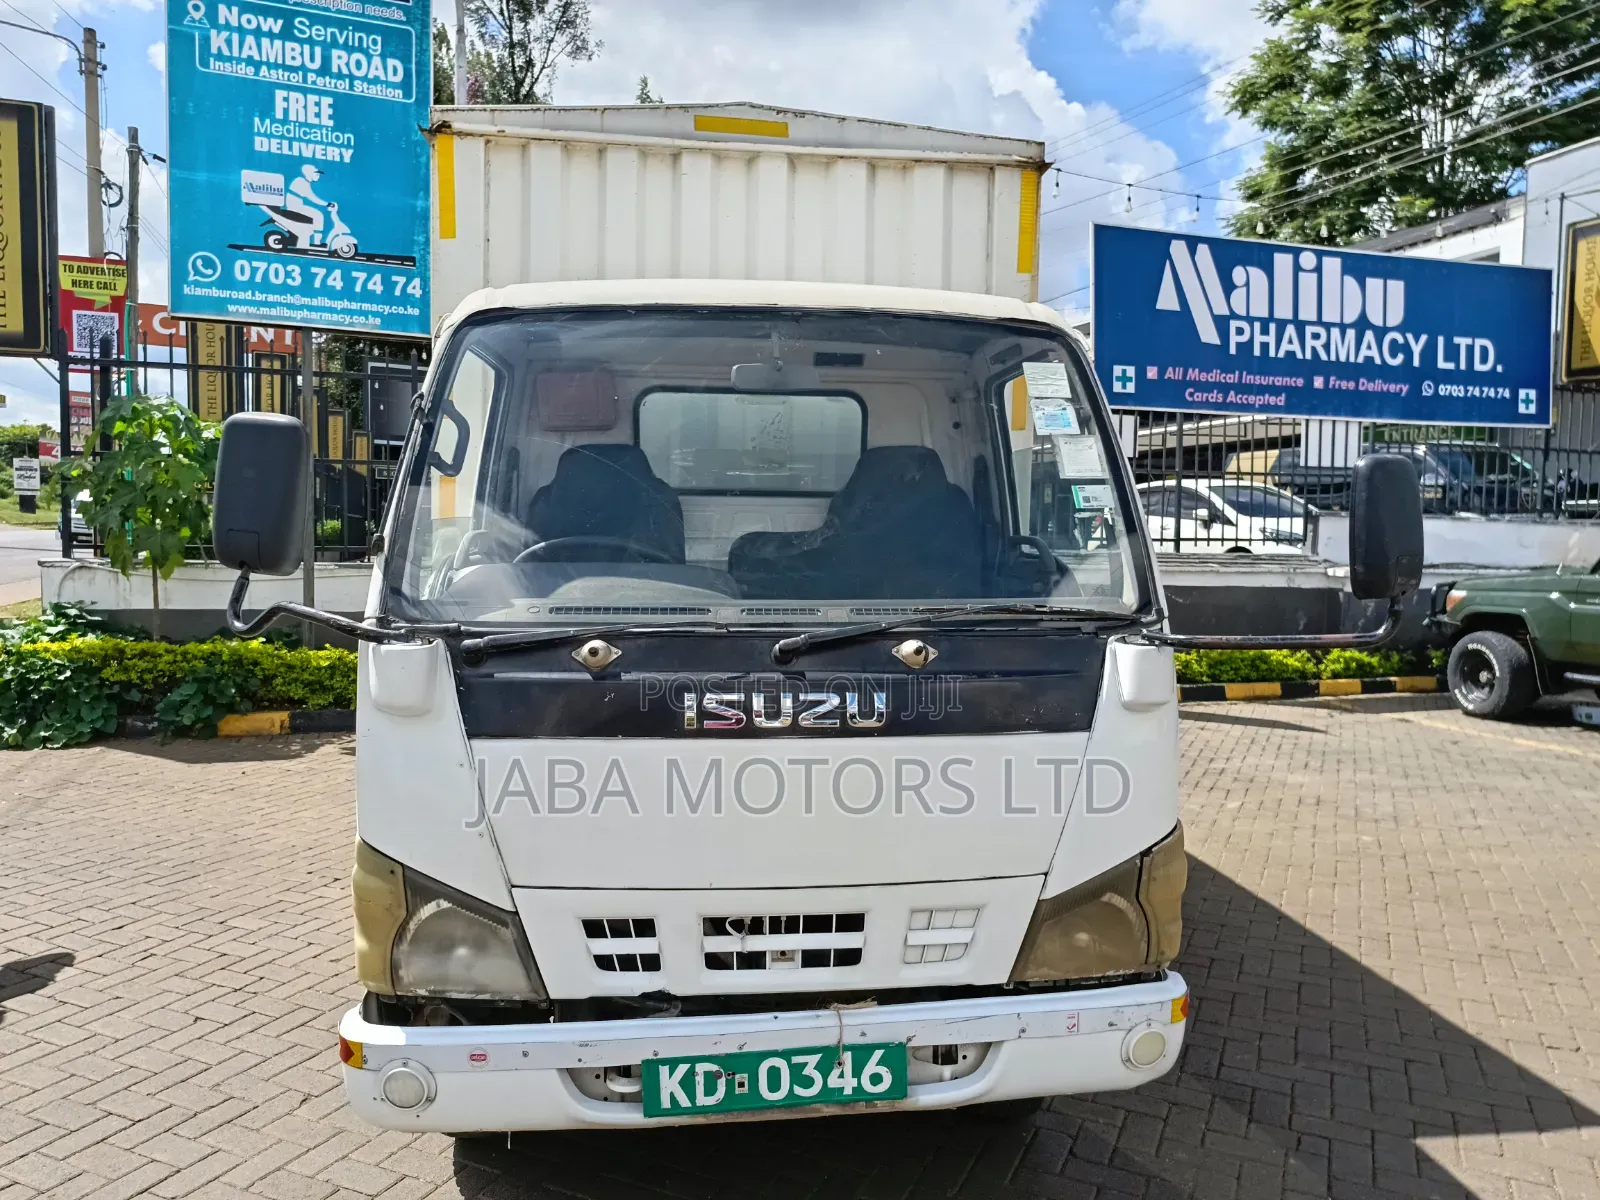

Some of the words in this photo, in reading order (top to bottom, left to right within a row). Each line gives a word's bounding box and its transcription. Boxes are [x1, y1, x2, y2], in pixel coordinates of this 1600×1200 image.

[289, 0, 362, 14] scription
[365, 5, 406, 21] needs.
[218, 4, 283, 34] Now
[293, 18, 382, 55] Serving
[210, 29, 322, 69] KIAMBU
[332, 49, 404, 83] ROAD
[210, 57, 255, 75] Inside
[259, 65, 303, 83] Astrol
[307, 74, 349, 91] Petrol
[353, 80, 403, 99] Station
[275, 89, 334, 126] FREE
[254, 117, 355, 146] Medication
[254, 137, 355, 163] DELIVERY
[243, 181, 284, 193] Malibu
[62, 264, 75, 273] TO
[77, 265, 127, 278] ADVERTISE
[234, 259, 302, 286] 0703
[310, 267, 343, 292] 74
[351, 271, 384, 295] 74
[391, 276, 423, 298] 74
[71, 279, 95, 290] HERE
[96, 281, 118, 291] CALL
[1155, 239, 1405, 345] Malibu
[184, 285, 420, 316] kiamburoad.branch@malibupharmacy.co.ke
[227, 303, 382, 326] www.malibupharmacy.co.ke
[1229, 320, 1428, 367] PHARMACY
[1437, 335, 1503, 373] LTD.
[206, 351, 218, 392] LIQOR
[1164, 367, 1184, 380] All
[1186, 368, 1239, 383] Medical
[1242, 371, 1305, 387] Insurance
[1185, 388, 1223, 403] Cards
[1226, 390, 1286, 408] Accepted
[1328, 376, 1356, 390] Free
[1358, 378, 1410, 397] Delivery
[1438, 384, 1465, 397] 0703
[206, 396, 218, 416] THE
[1384, 425, 1457, 442] ENTRANCE
[684, 692, 887, 729] ISUZU
[658, 1062, 727, 1109] KD
[757, 1049, 893, 1100] 0346
